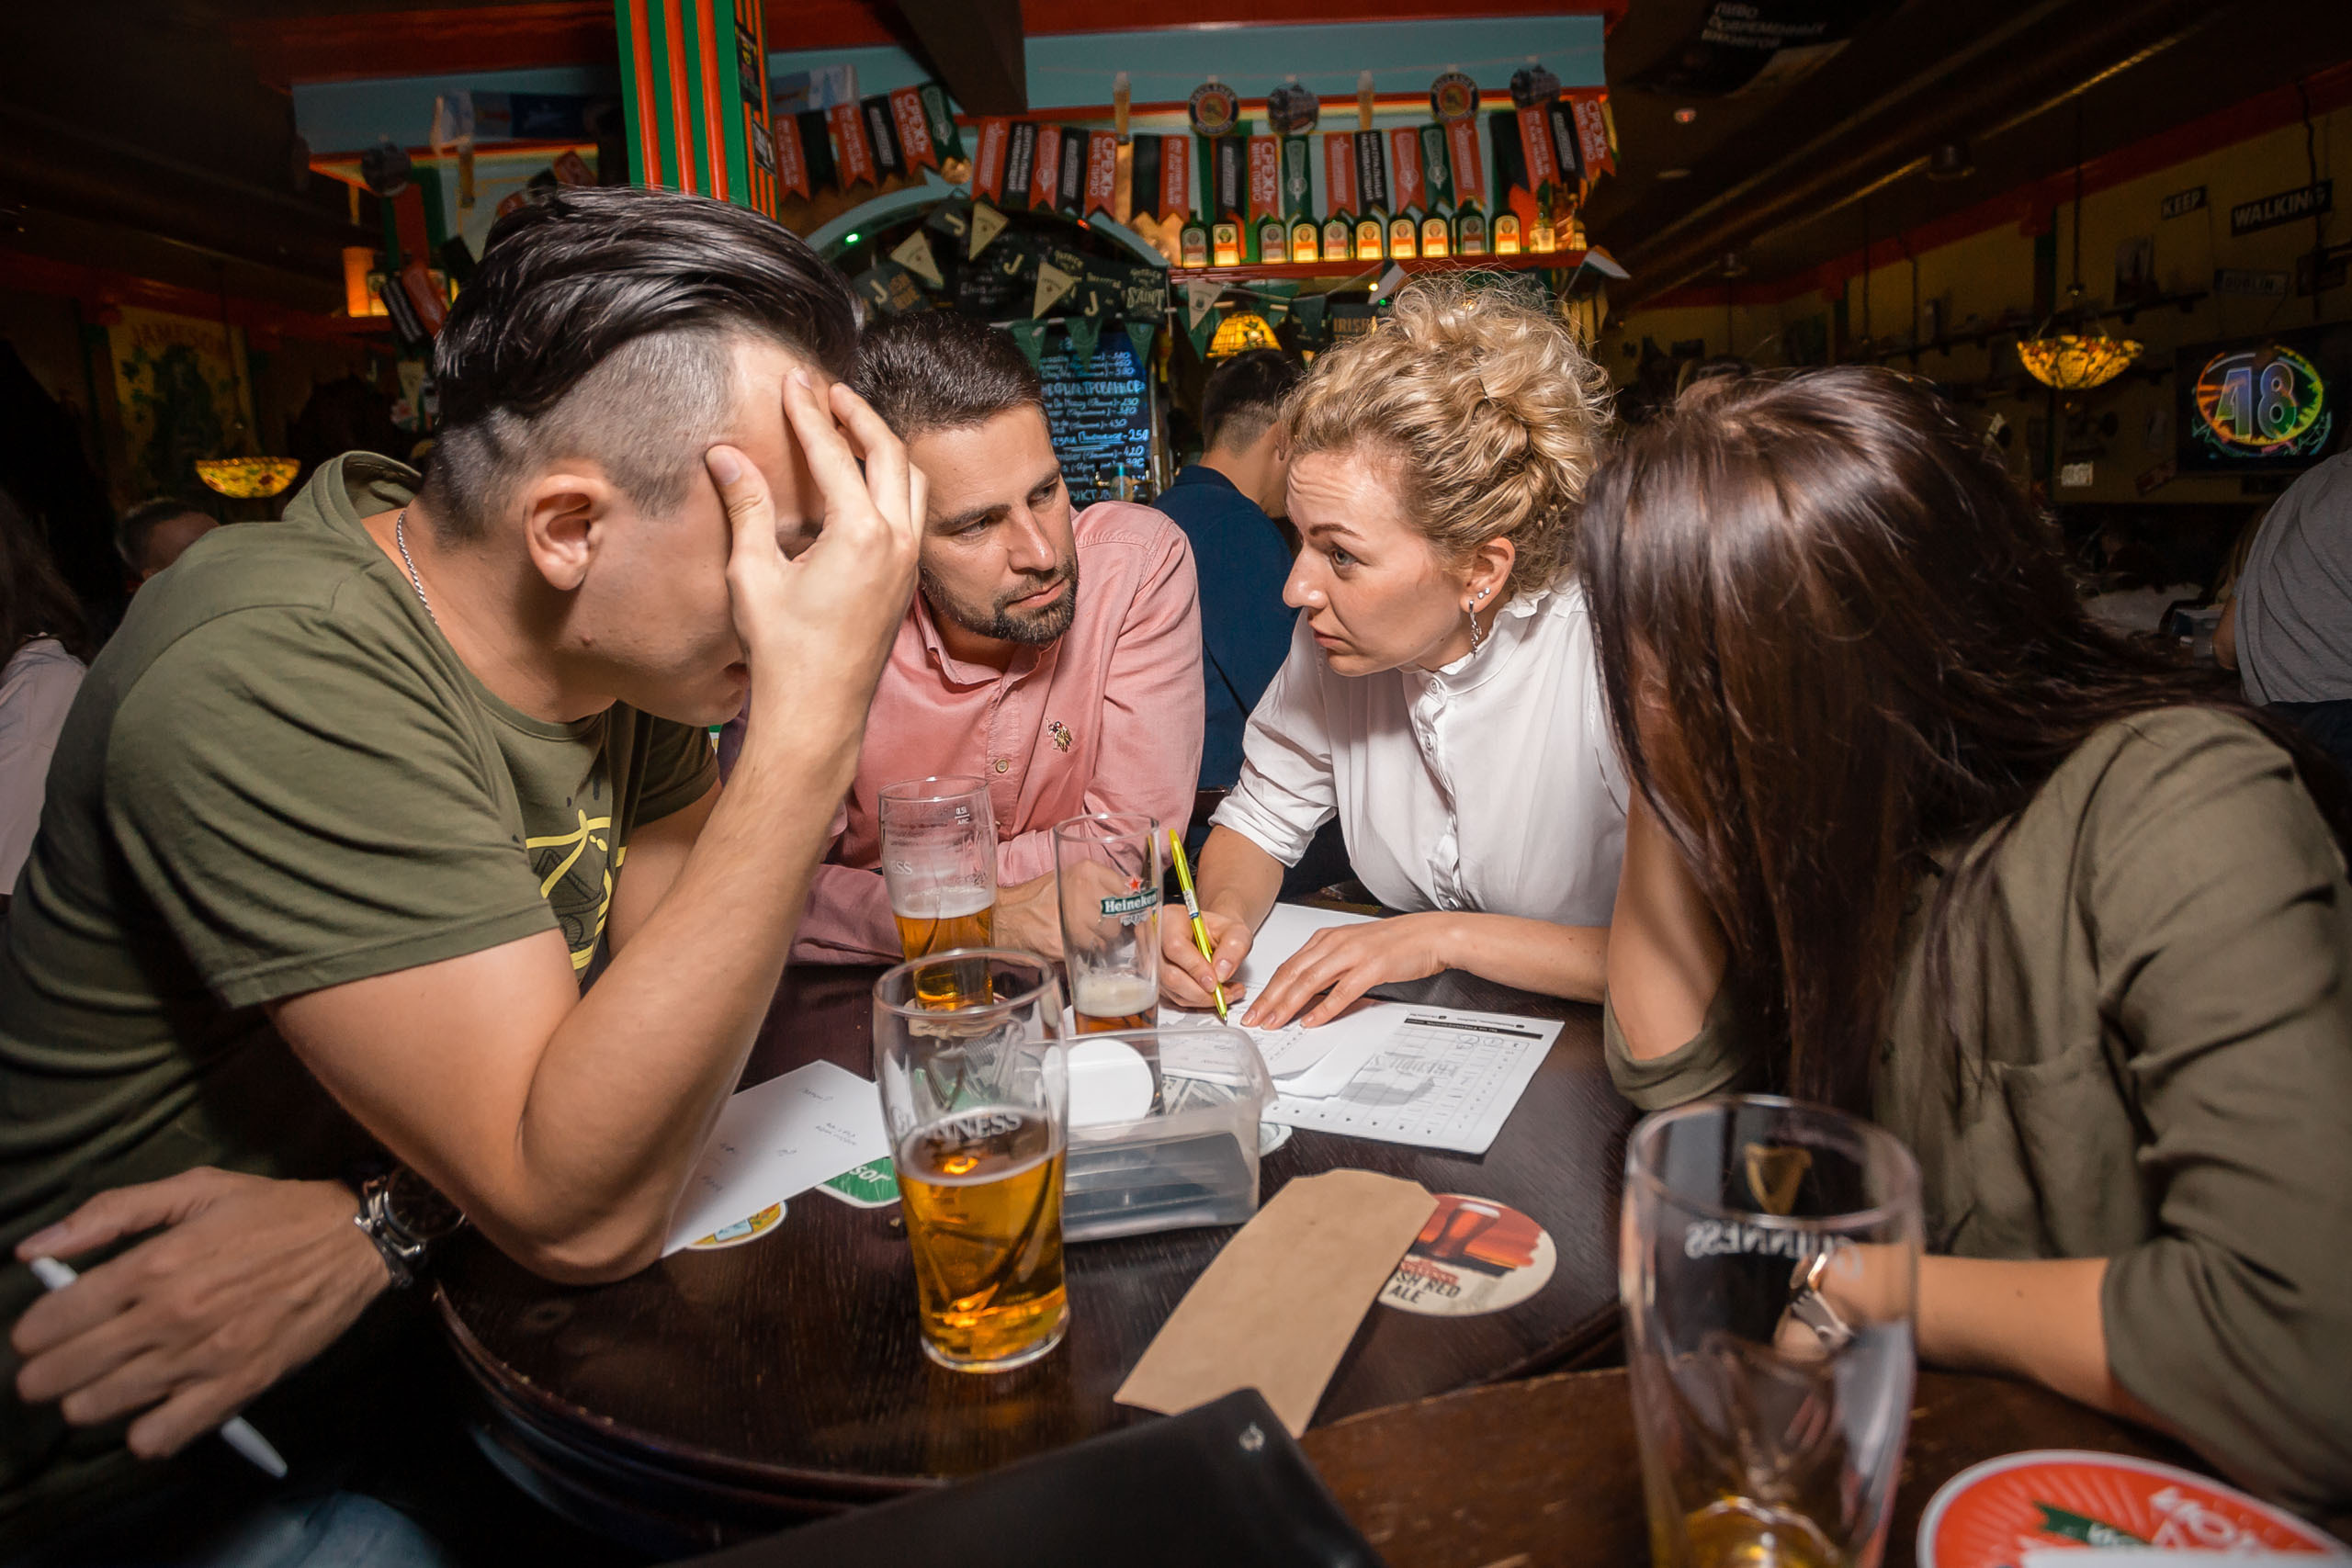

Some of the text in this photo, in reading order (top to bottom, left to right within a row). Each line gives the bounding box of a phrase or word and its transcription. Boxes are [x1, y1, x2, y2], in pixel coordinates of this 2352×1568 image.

[2163, 190, 2201, 218] KEEP
[889, 860, 913, 875] ESS
[1104, 892, 1158, 914] Heineken
[849, 1164, 892, 1183] sor
[1388, 1285, 1426, 1305] ALE
